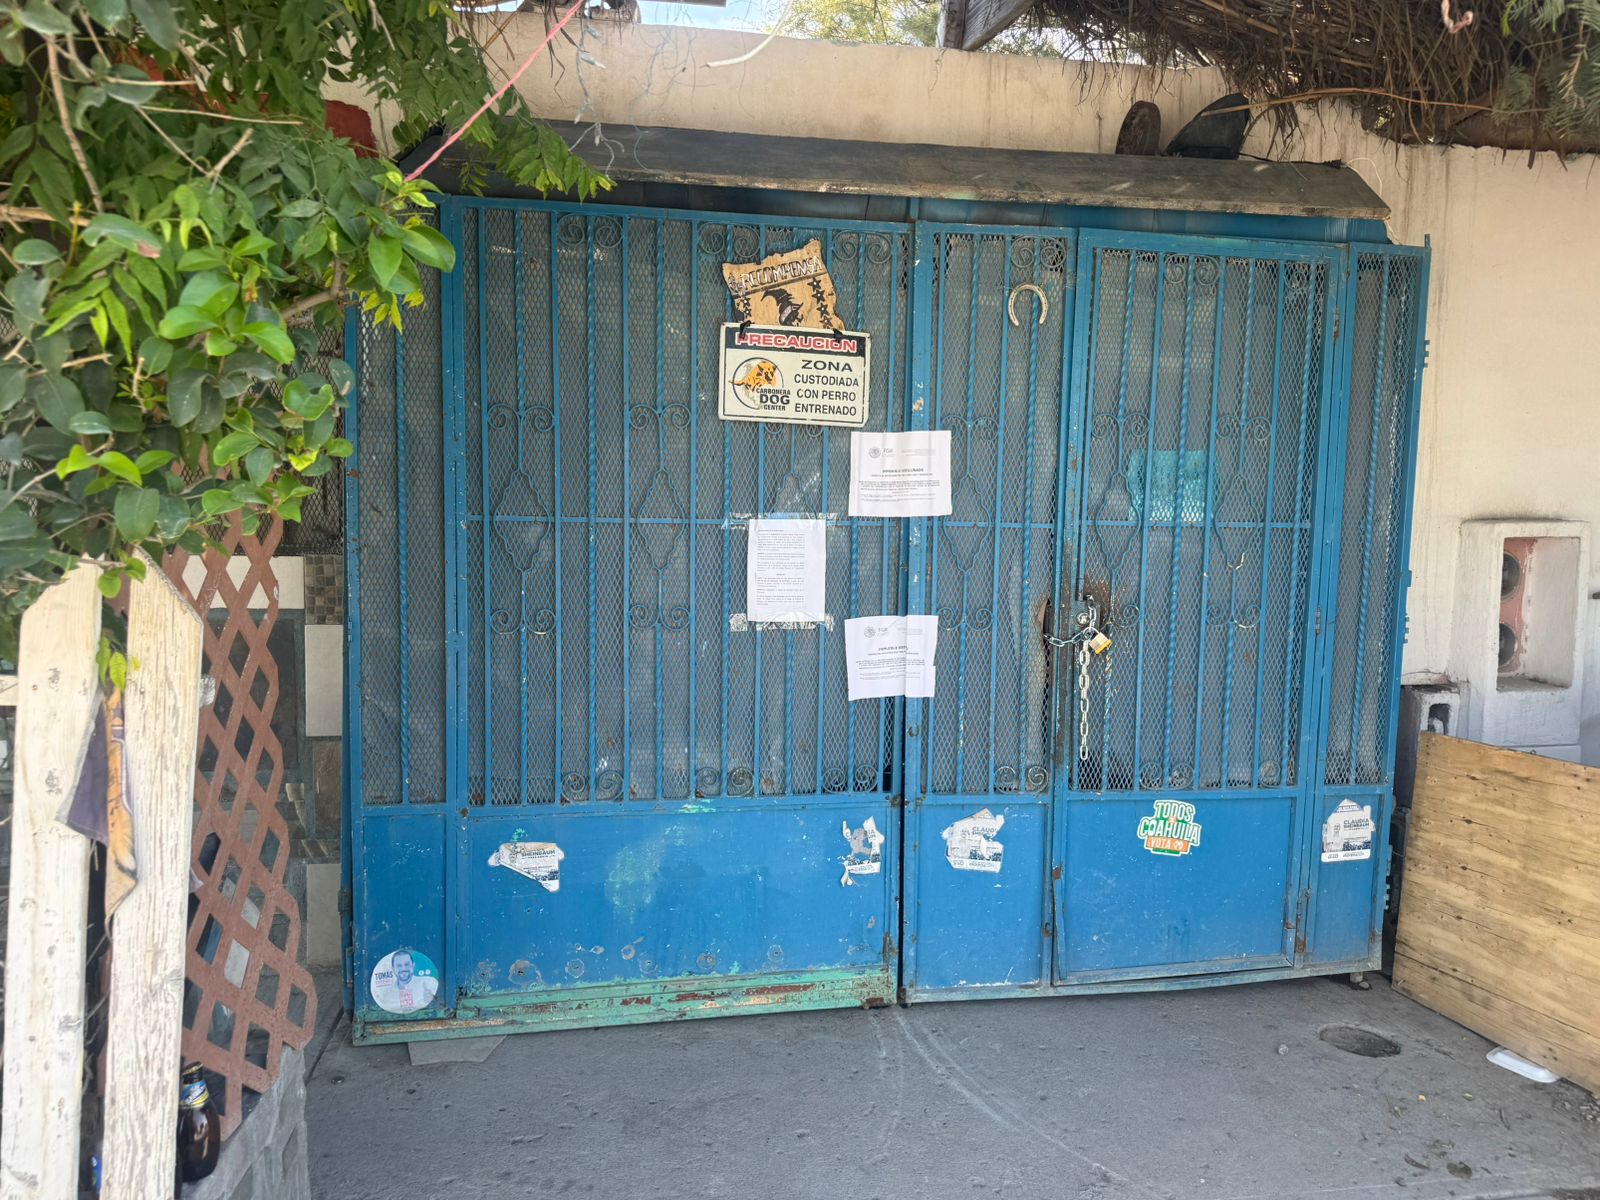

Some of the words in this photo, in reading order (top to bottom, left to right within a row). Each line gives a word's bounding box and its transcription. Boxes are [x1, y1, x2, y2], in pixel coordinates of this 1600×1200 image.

[740, 256, 822, 289] RECOMPENSA
[801, 360, 853, 372] ZONA
[794, 373, 859, 387] CUSTODIADA
[760, 394, 790, 405] DOG
[796, 388, 819, 399] CON
[821, 390, 856, 401] PERRO
[794, 403, 857, 416] ENTRENADO
[1156, 802, 1194, 822] TODOS
[1139, 819, 1200, 844] COAHUILA
[1151, 836, 1171, 849] VOTA
